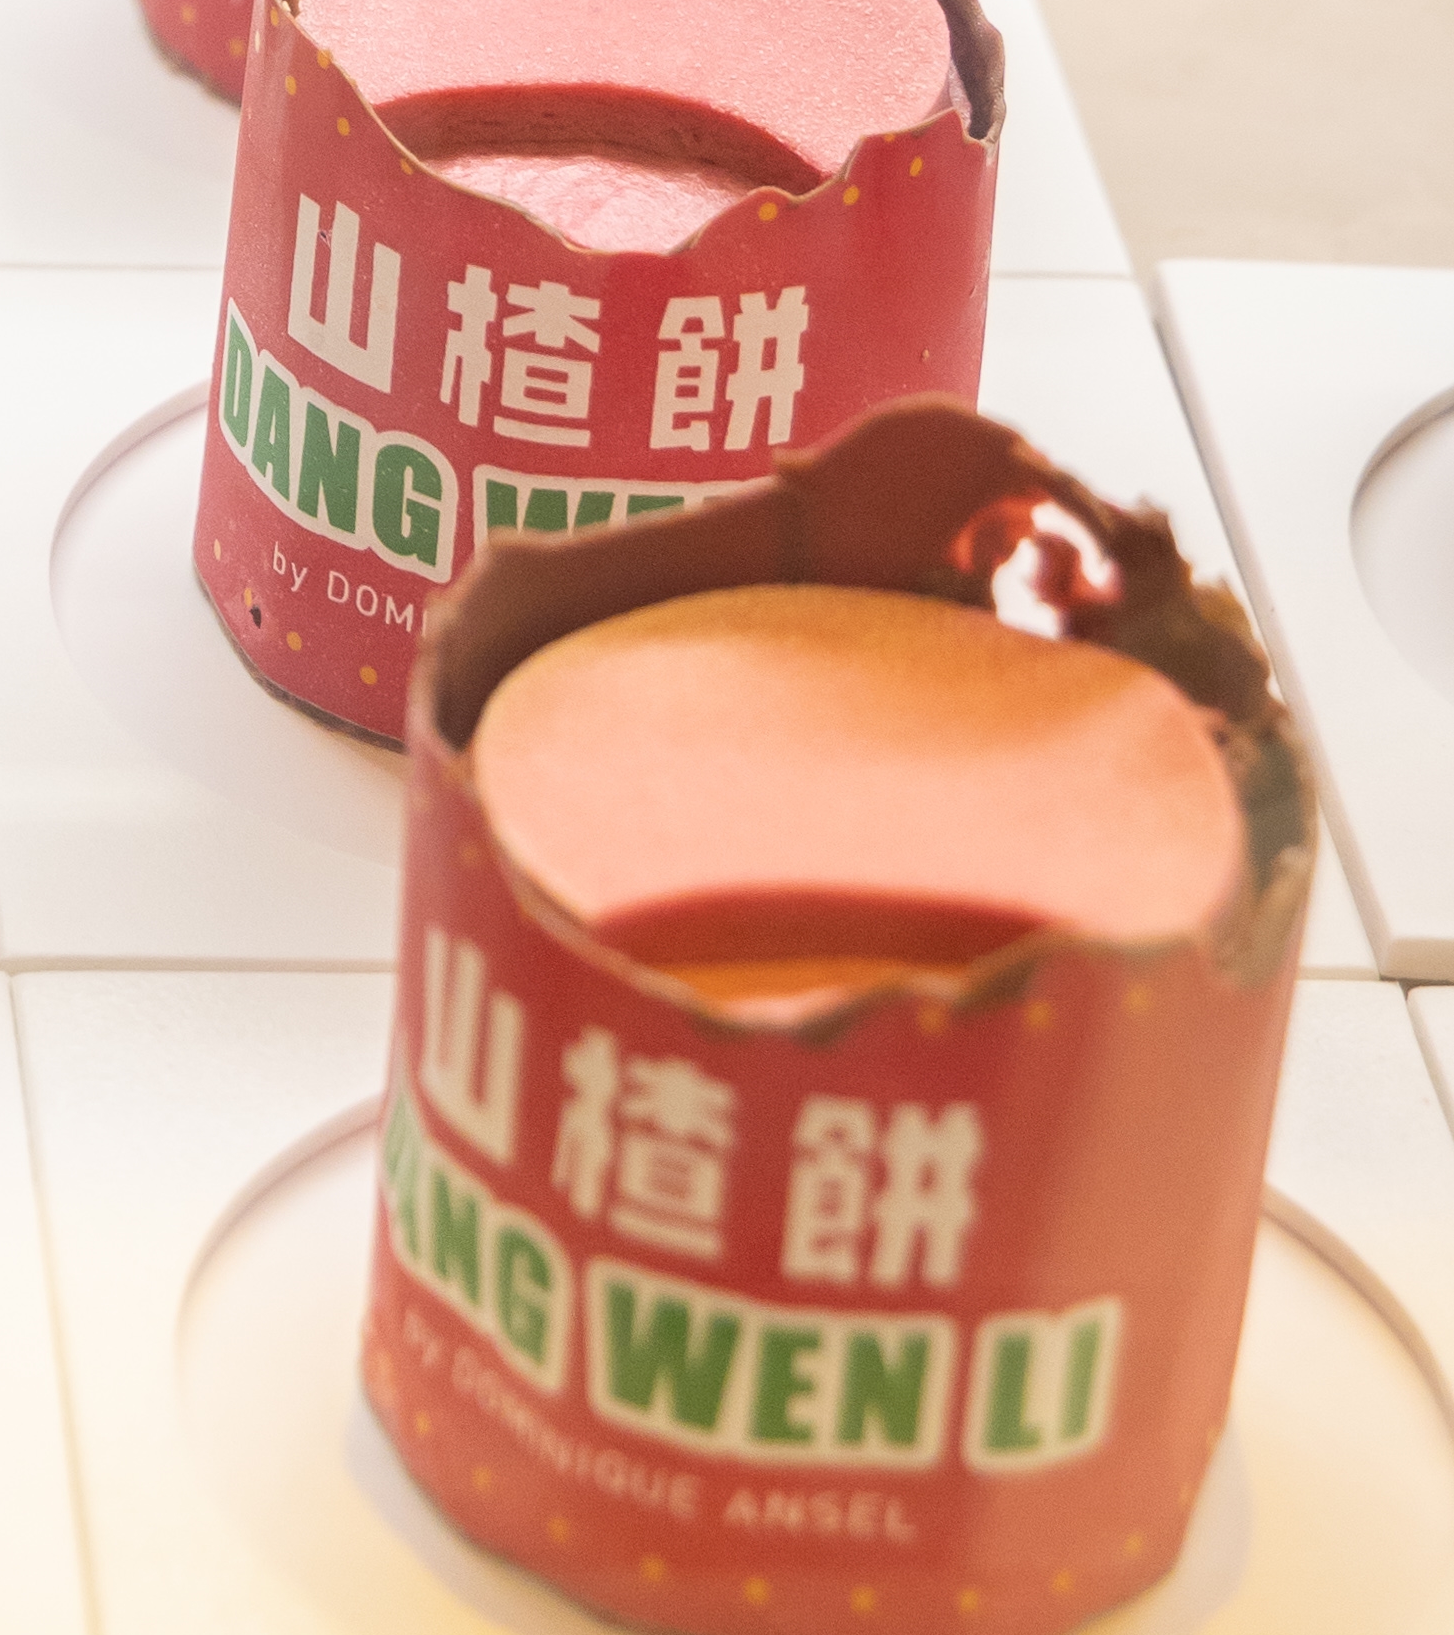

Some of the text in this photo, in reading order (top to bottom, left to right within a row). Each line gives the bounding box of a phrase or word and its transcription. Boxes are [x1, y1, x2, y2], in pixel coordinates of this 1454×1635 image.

[288, 193, 808, 450] 山楂餅
[220, 311, 450, 575] DANG
[272, 541, 308, 592] by
[421, 929, 981, 1286] 山楂餅
[601, 1274, 938, 1456] WEN
[978, 1312, 1107, 1461] LI
[723, 1487, 919, 1543] ANSEL
